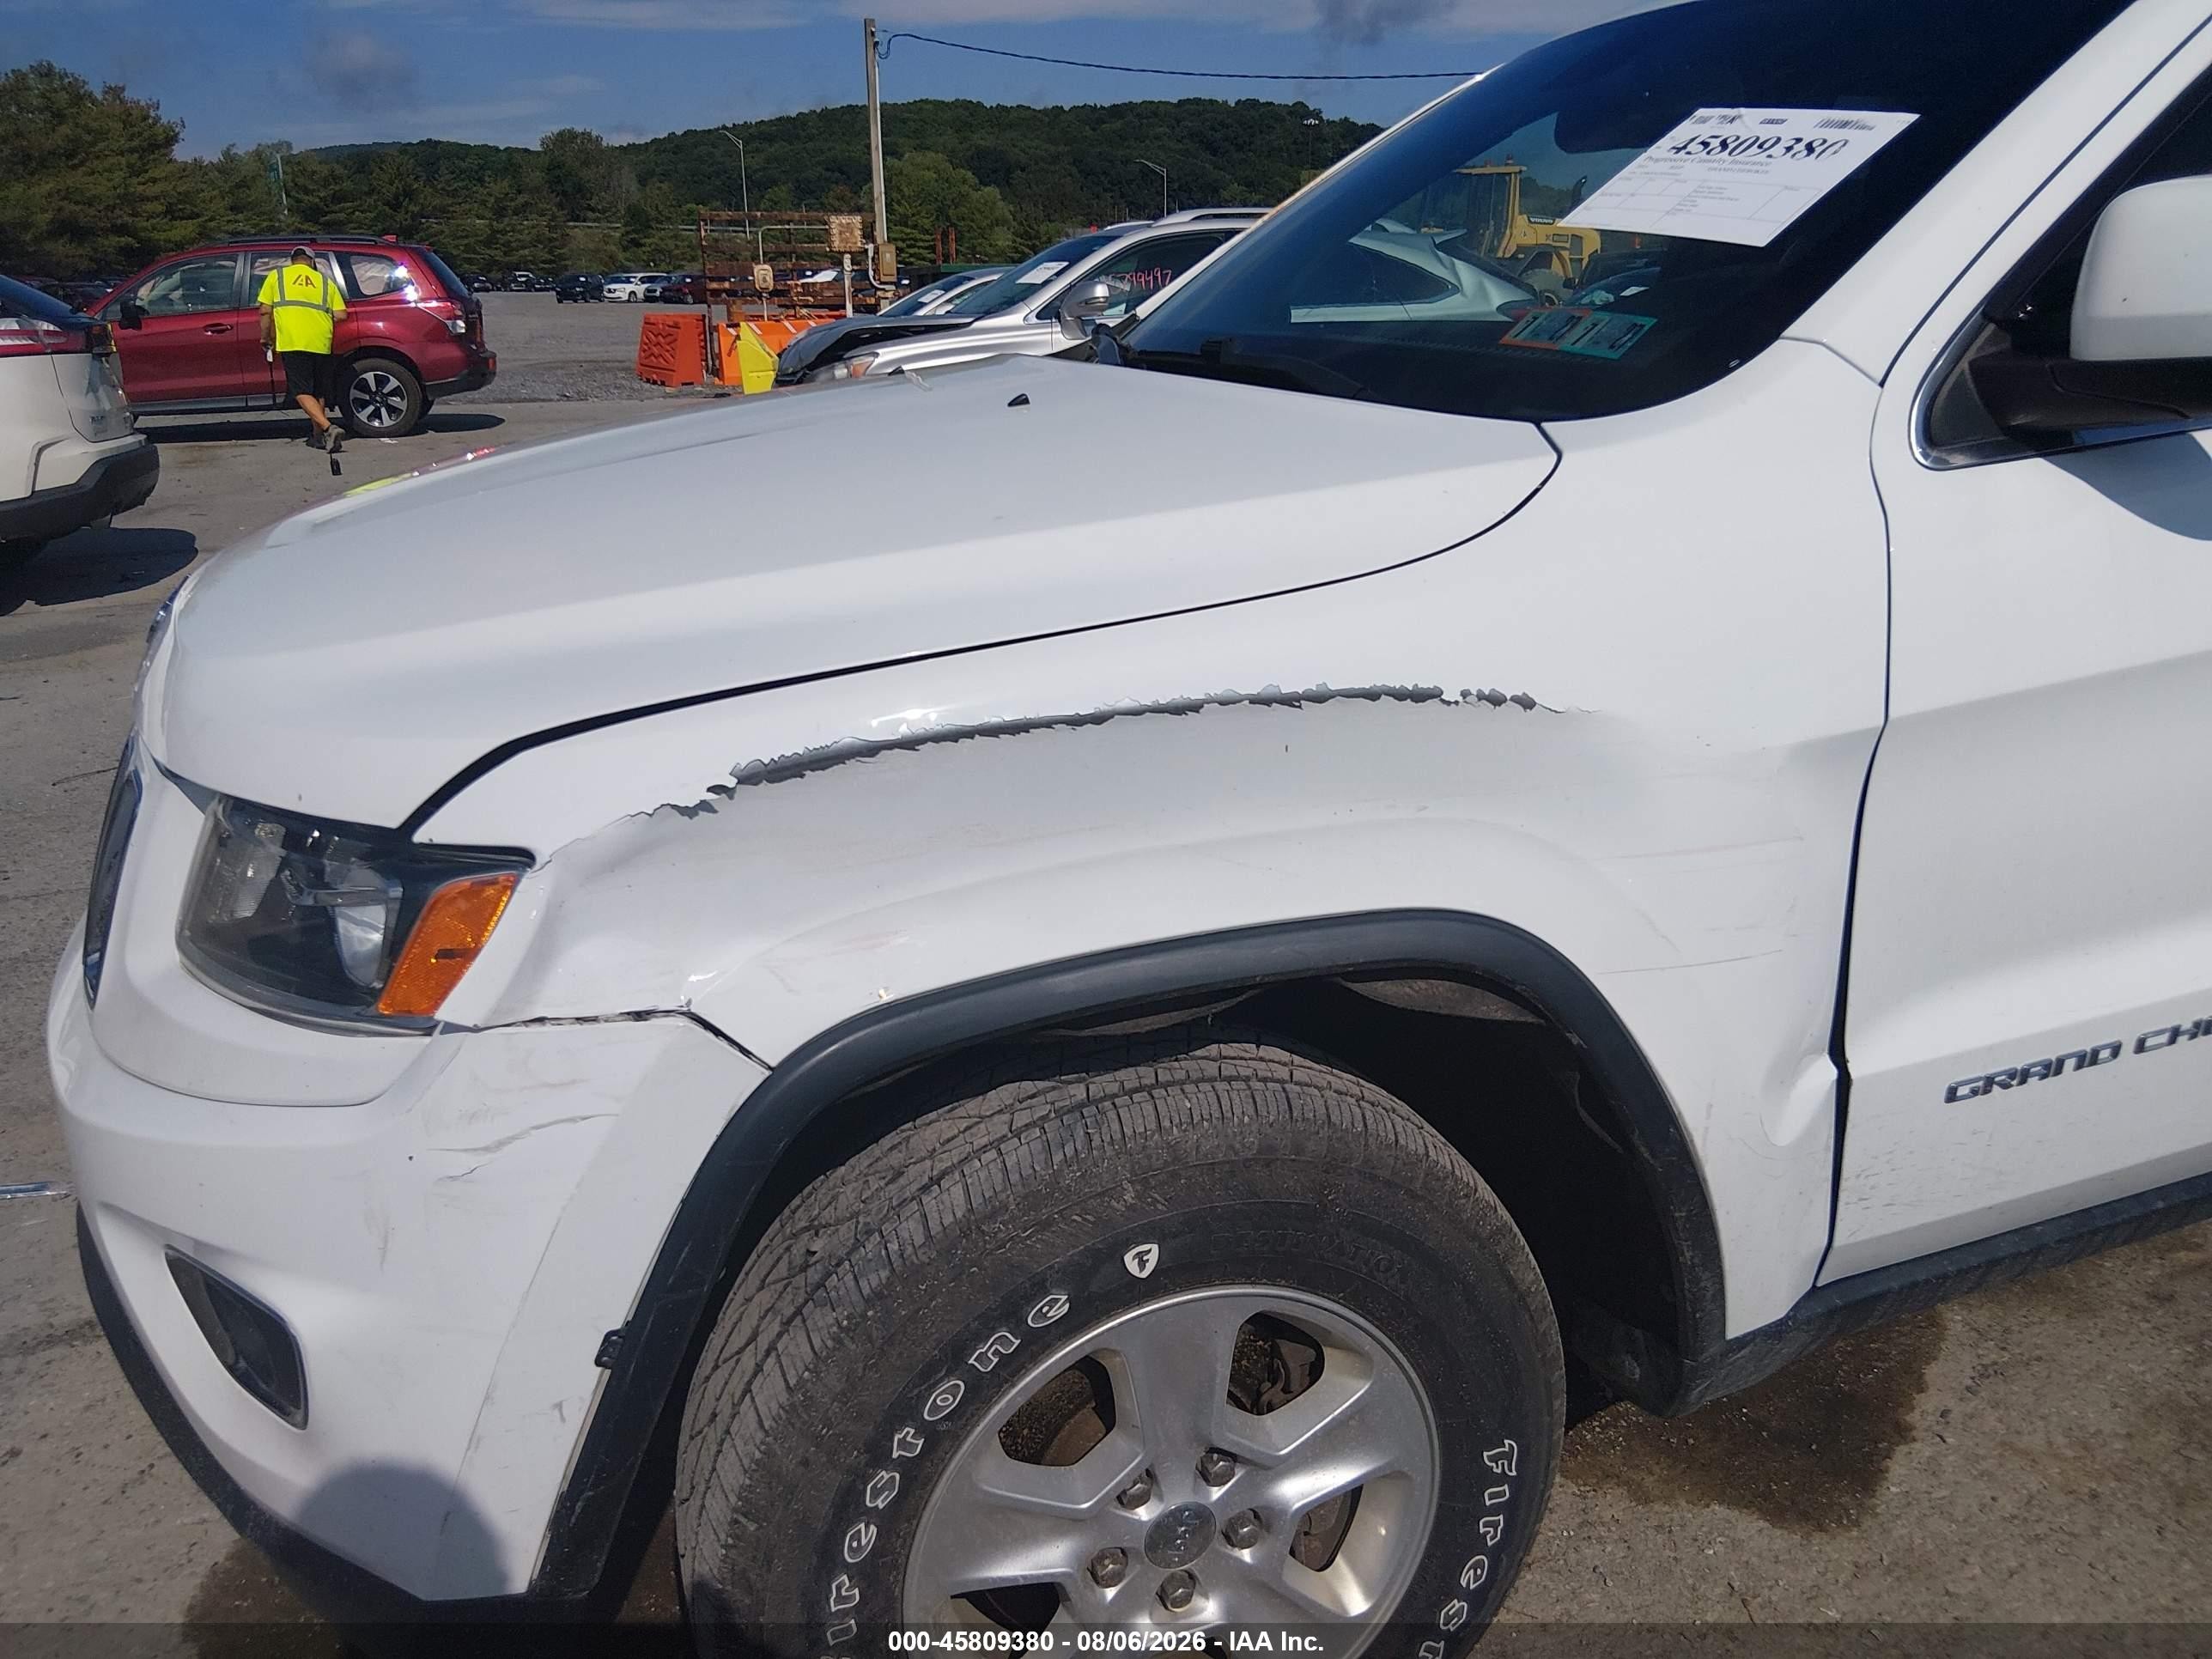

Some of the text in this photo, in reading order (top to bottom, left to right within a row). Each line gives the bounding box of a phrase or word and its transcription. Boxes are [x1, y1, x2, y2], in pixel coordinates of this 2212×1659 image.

[1667, 134, 1850, 161] 45809380
[1944, 1039, 2123, 1104] GRAND
[820, 1293, 1070, 1659] irestone
